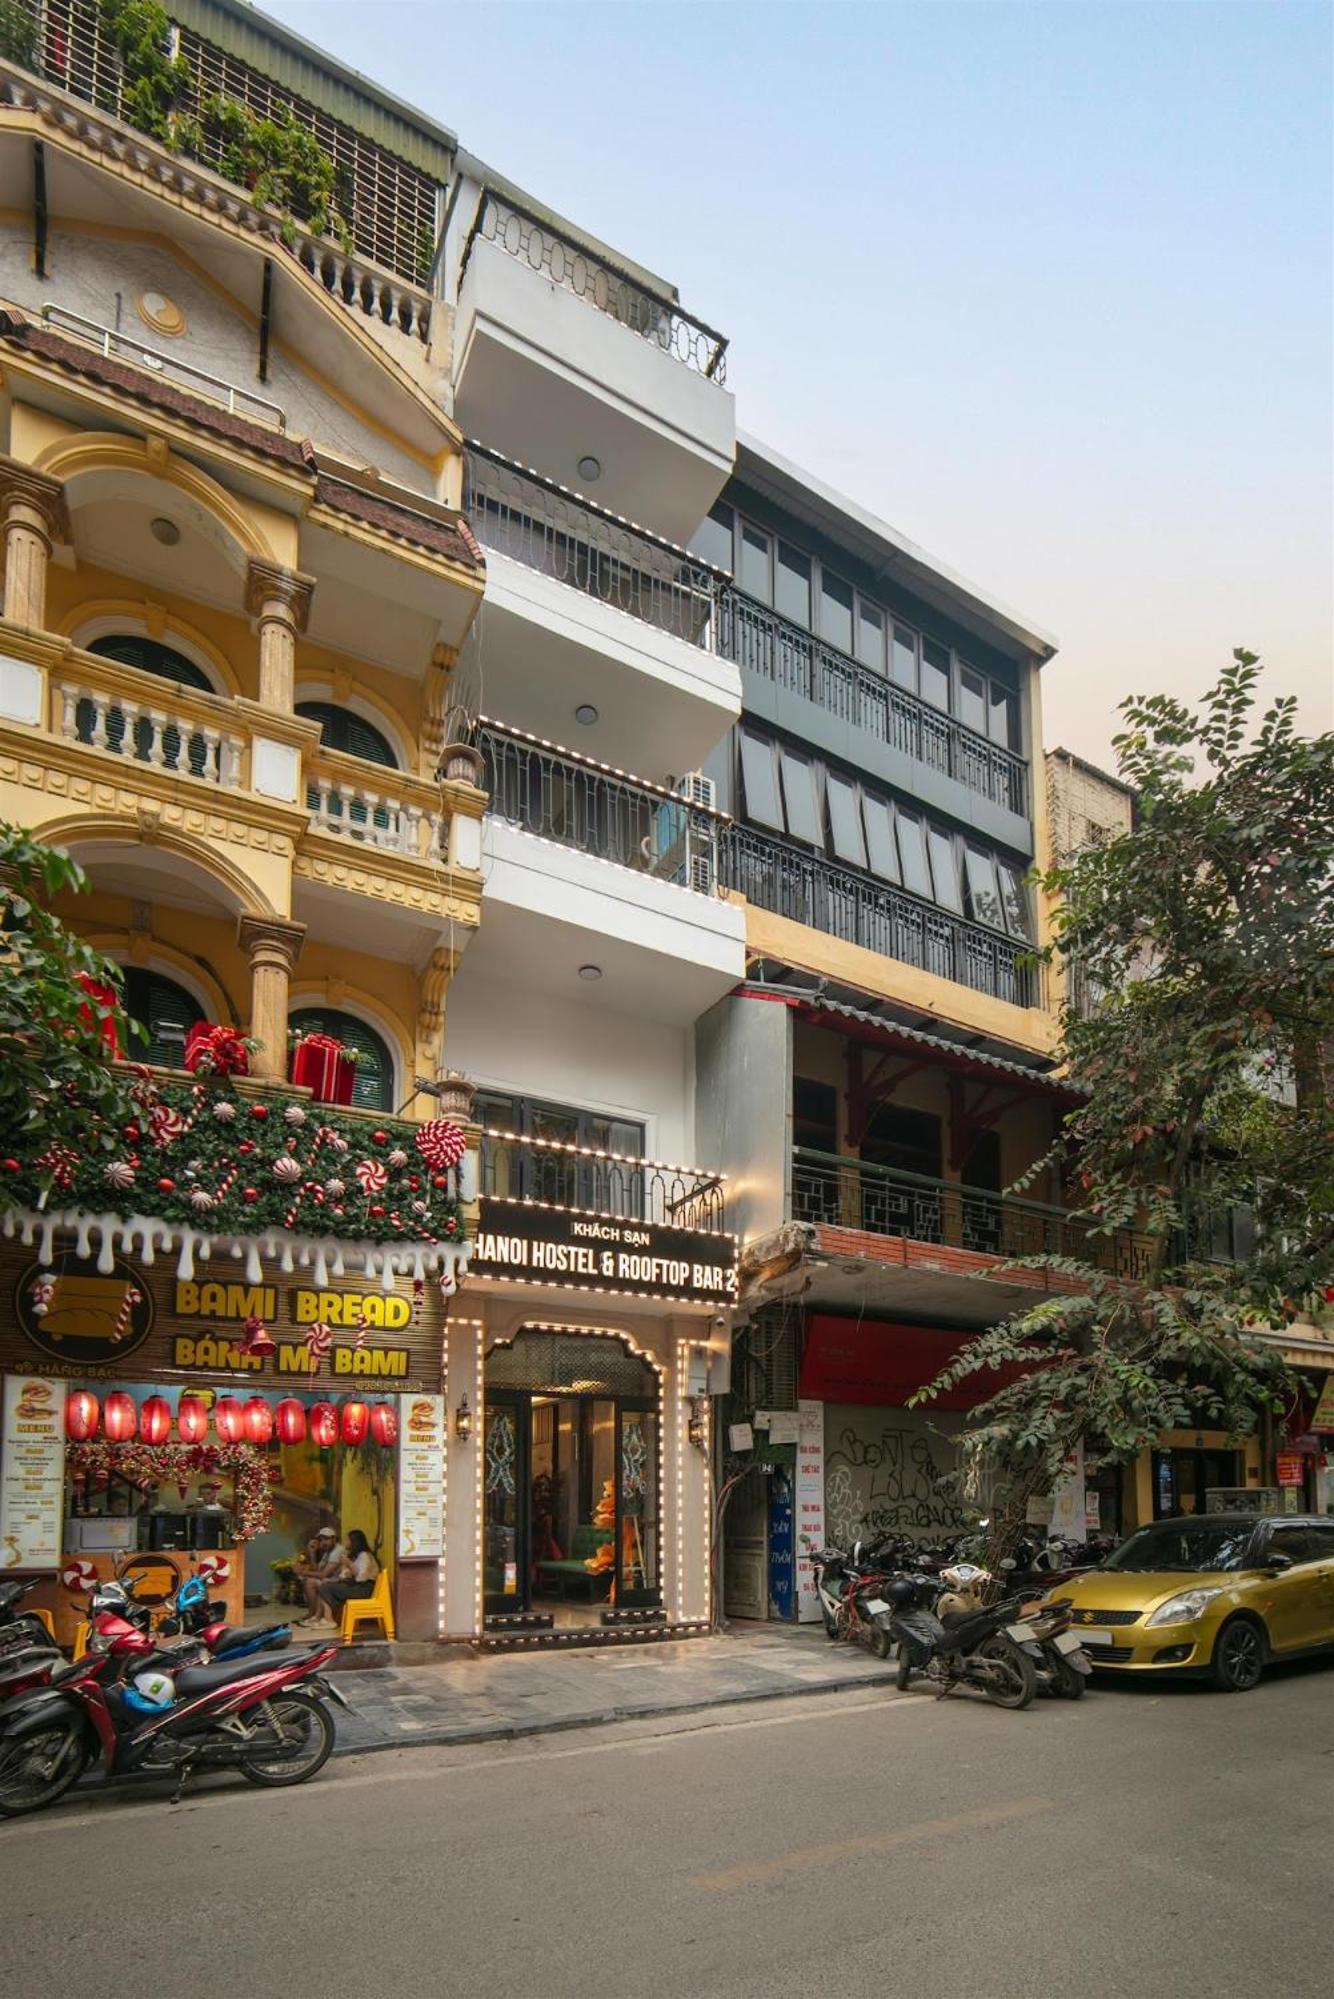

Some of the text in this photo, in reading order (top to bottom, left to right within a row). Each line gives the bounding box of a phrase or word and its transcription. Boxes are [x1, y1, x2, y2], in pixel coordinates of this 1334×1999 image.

[573, 1221, 650, 1247] KHÁCH SẠN
[532, 1241, 598, 1274] HOSTEL
[601, 1251, 614, 1277] &
[618, 1253, 690, 1286] ROOFTOP
[692, 1263, 723, 1291] BAR
[725, 1269, 736, 1292] 2
[176, 1281, 411, 1328] BAMI BREAD
[335, 1348, 408, 1376] BAMI
